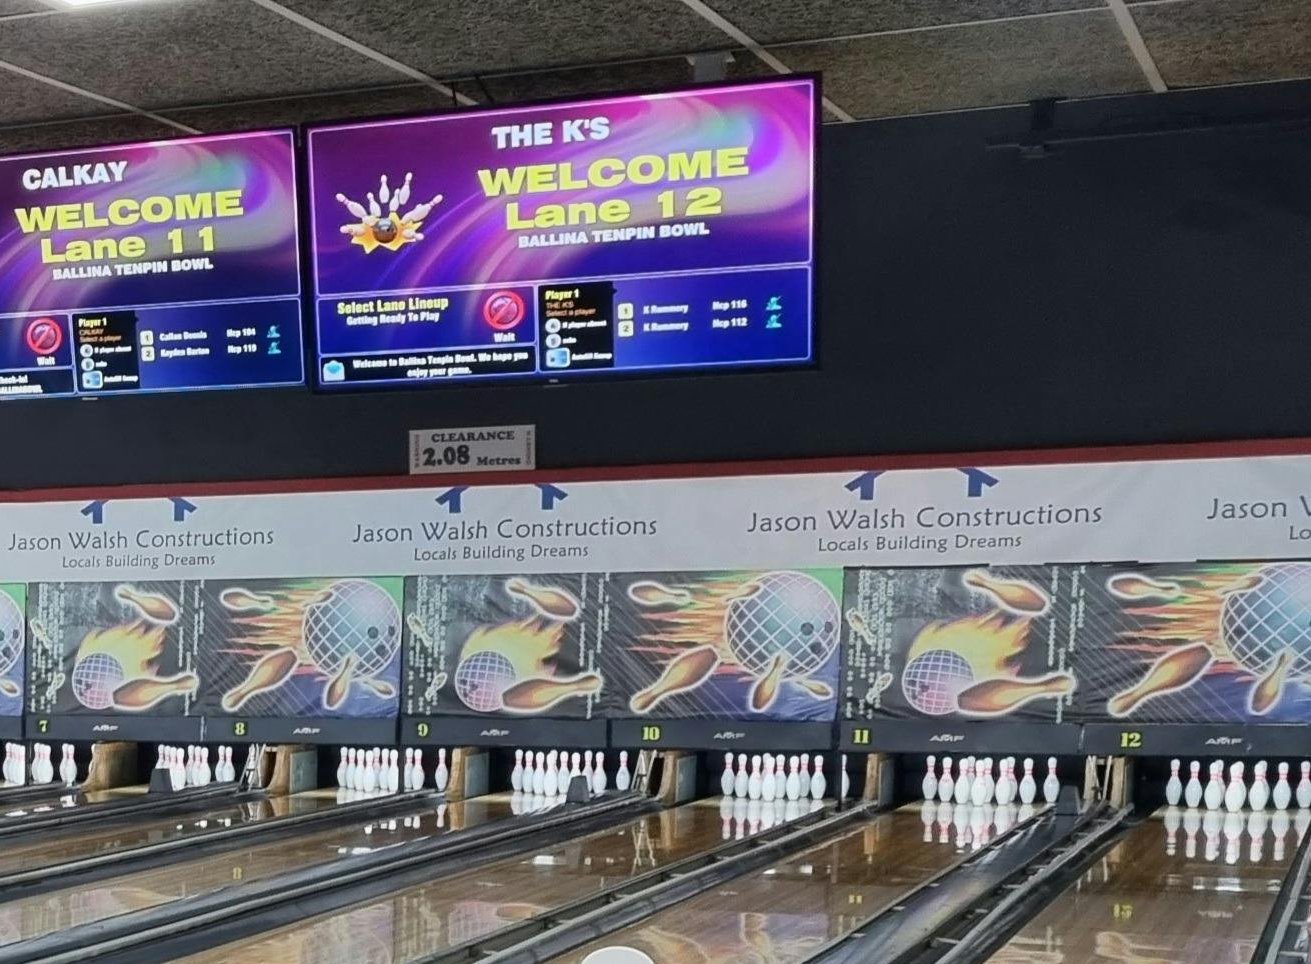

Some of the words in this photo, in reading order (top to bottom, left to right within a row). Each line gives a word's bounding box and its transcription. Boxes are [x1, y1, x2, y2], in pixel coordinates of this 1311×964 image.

[492, 123, 552, 149] THE
[562, 117, 609, 141] K'S
[23, 161, 127, 190] CALKAY
[477, 147, 749, 197] WELCOME
[15, 190, 243, 233] WELCOME
[507, 197, 630, 230] Lane
[657, 187, 722, 218] 12
[519, 230, 587, 248] BALLINA
[592, 226, 655, 242] TENPIN
[659, 223, 709, 238] BOWL
[41, 234, 145, 264] Lane
[168, 227, 214, 254] 11
[53, 265, 111, 280] BALLINA
[115, 261, 167, 276] TENPIN
[171, 258, 213, 271] BOWL
[545, 291, 572, 300] Player
[574, 289, 579, 298] 1
[337, 301, 374, 314] Select
[377, 301, 405, 312] Lane
[409, 298, 449, 311] Lineup
[347, 316, 377, 326] Getting
[380, 314, 406, 325] Ready
[408, 314, 418, 322] To
[421, 312, 439, 322] Play
[494, 333, 515, 342] Wait
[37, 357, 55, 365] Wait
[431, 431, 515, 442] CLEARANCE
[423, 445, 470, 466] 2.08
[477, 456, 521, 466] Metres
[747, 512, 817, 533] Jason
[826, 508, 905, 531] Walsh
[916, 503, 1102, 528] Constructions
[1207, 498, 1287, 520] Jason
[353, 523, 412, 544] Jason
[421, 520, 488, 540] Walsh
[497, 515, 657, 538] Constructions
[8, 533, 61, 553] Jason
[68, 530, 128, 550] Walsh
[136, 527, 274, 548] Constructions
[818, 536, 870, 552] Locals
[876, 534, 948, 553] Building
[955, 533, 1022, 549] Dreams
[414, 546, 457, 560] Locals
[463, 544, 525, 560] Building
[531, 544, 588, 558] Dreams
[62, 555, 102, 568] Locals
[106, 554, 160, 570] Building
[164, 553, 216, 566] Dreams
[39, 719, 48, 733] 7
[234, 722, 245, 735] 8
[417, 724, 428, 737] 9
[642, 726, 660, 741] 10
[852, 730, 870, 744] 11
[1120, 732, 1141, 748] 12
